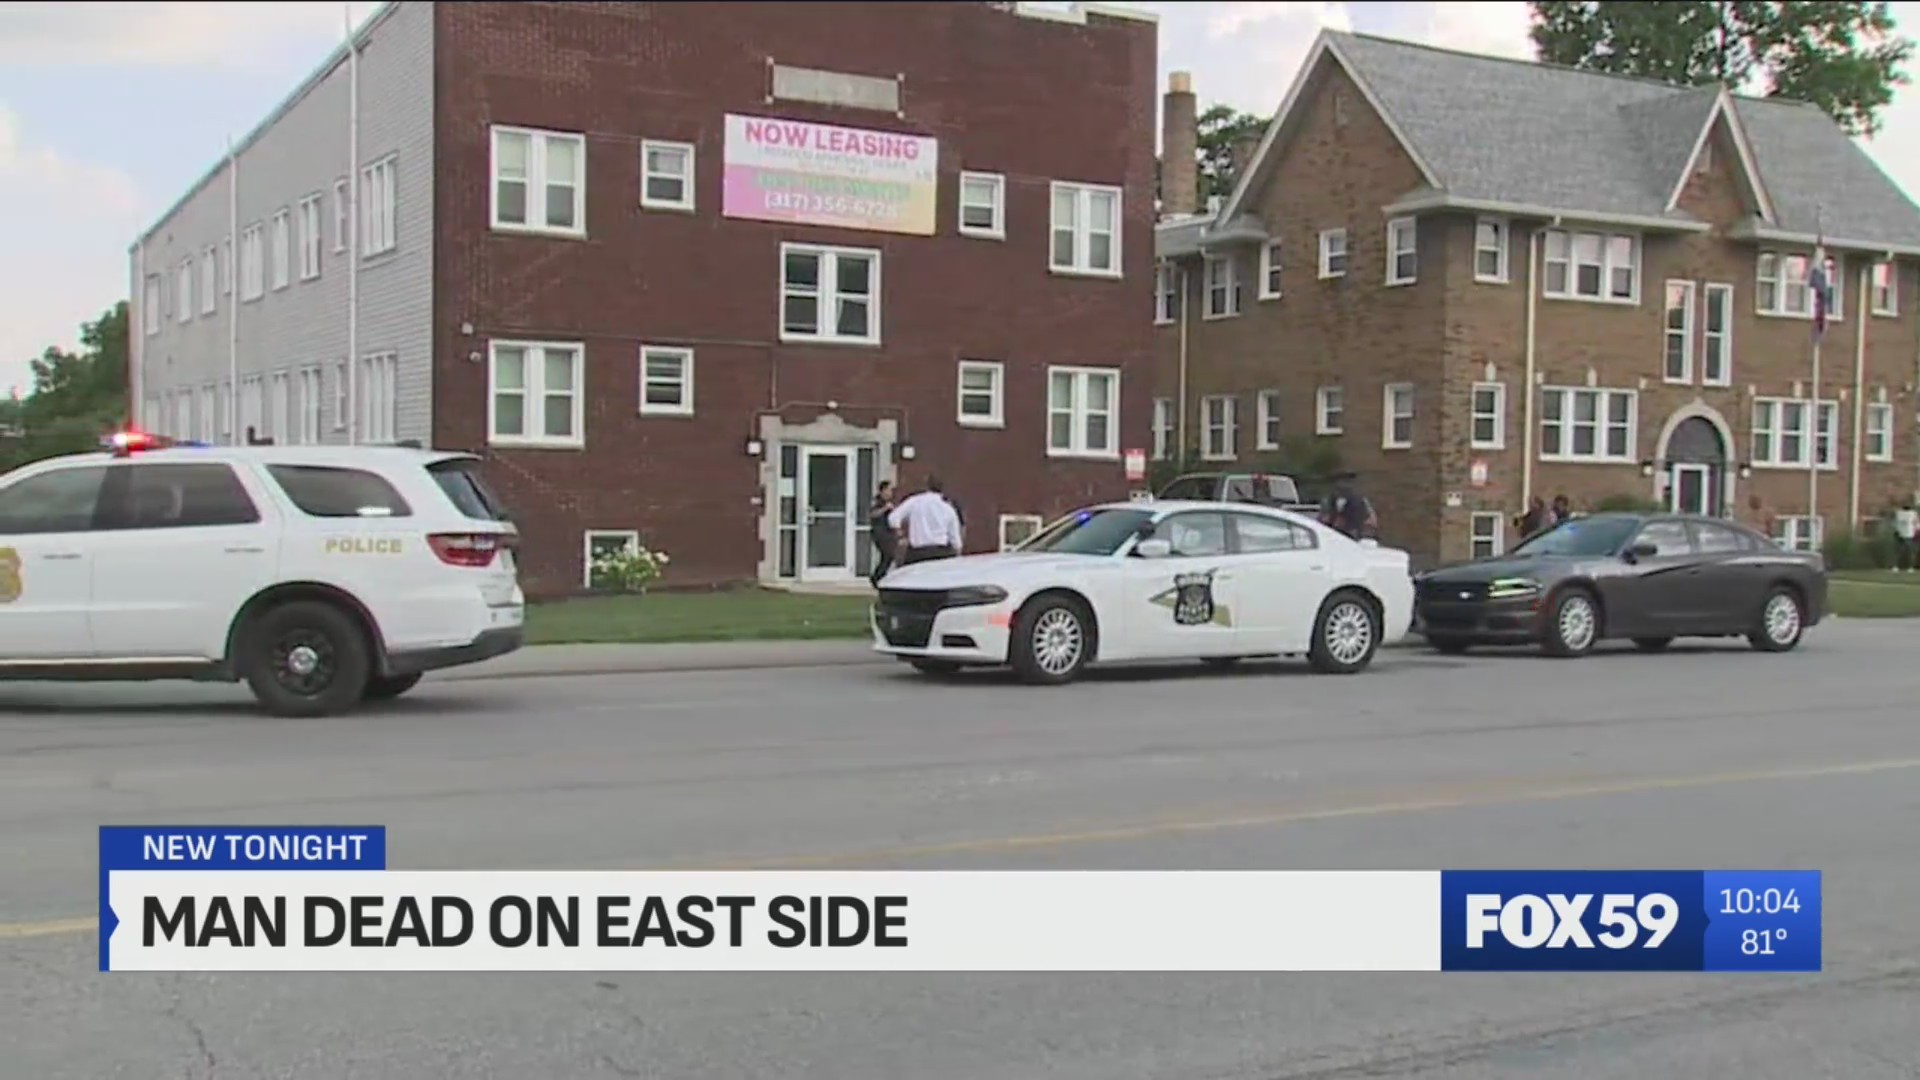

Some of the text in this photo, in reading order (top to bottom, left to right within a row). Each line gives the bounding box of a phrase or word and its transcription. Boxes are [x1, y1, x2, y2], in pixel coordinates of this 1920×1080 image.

[744, 121, 809, 149] NOW
[815, 128, 920, 161] LEASING
[325, 538, 402, 554] POLICE
